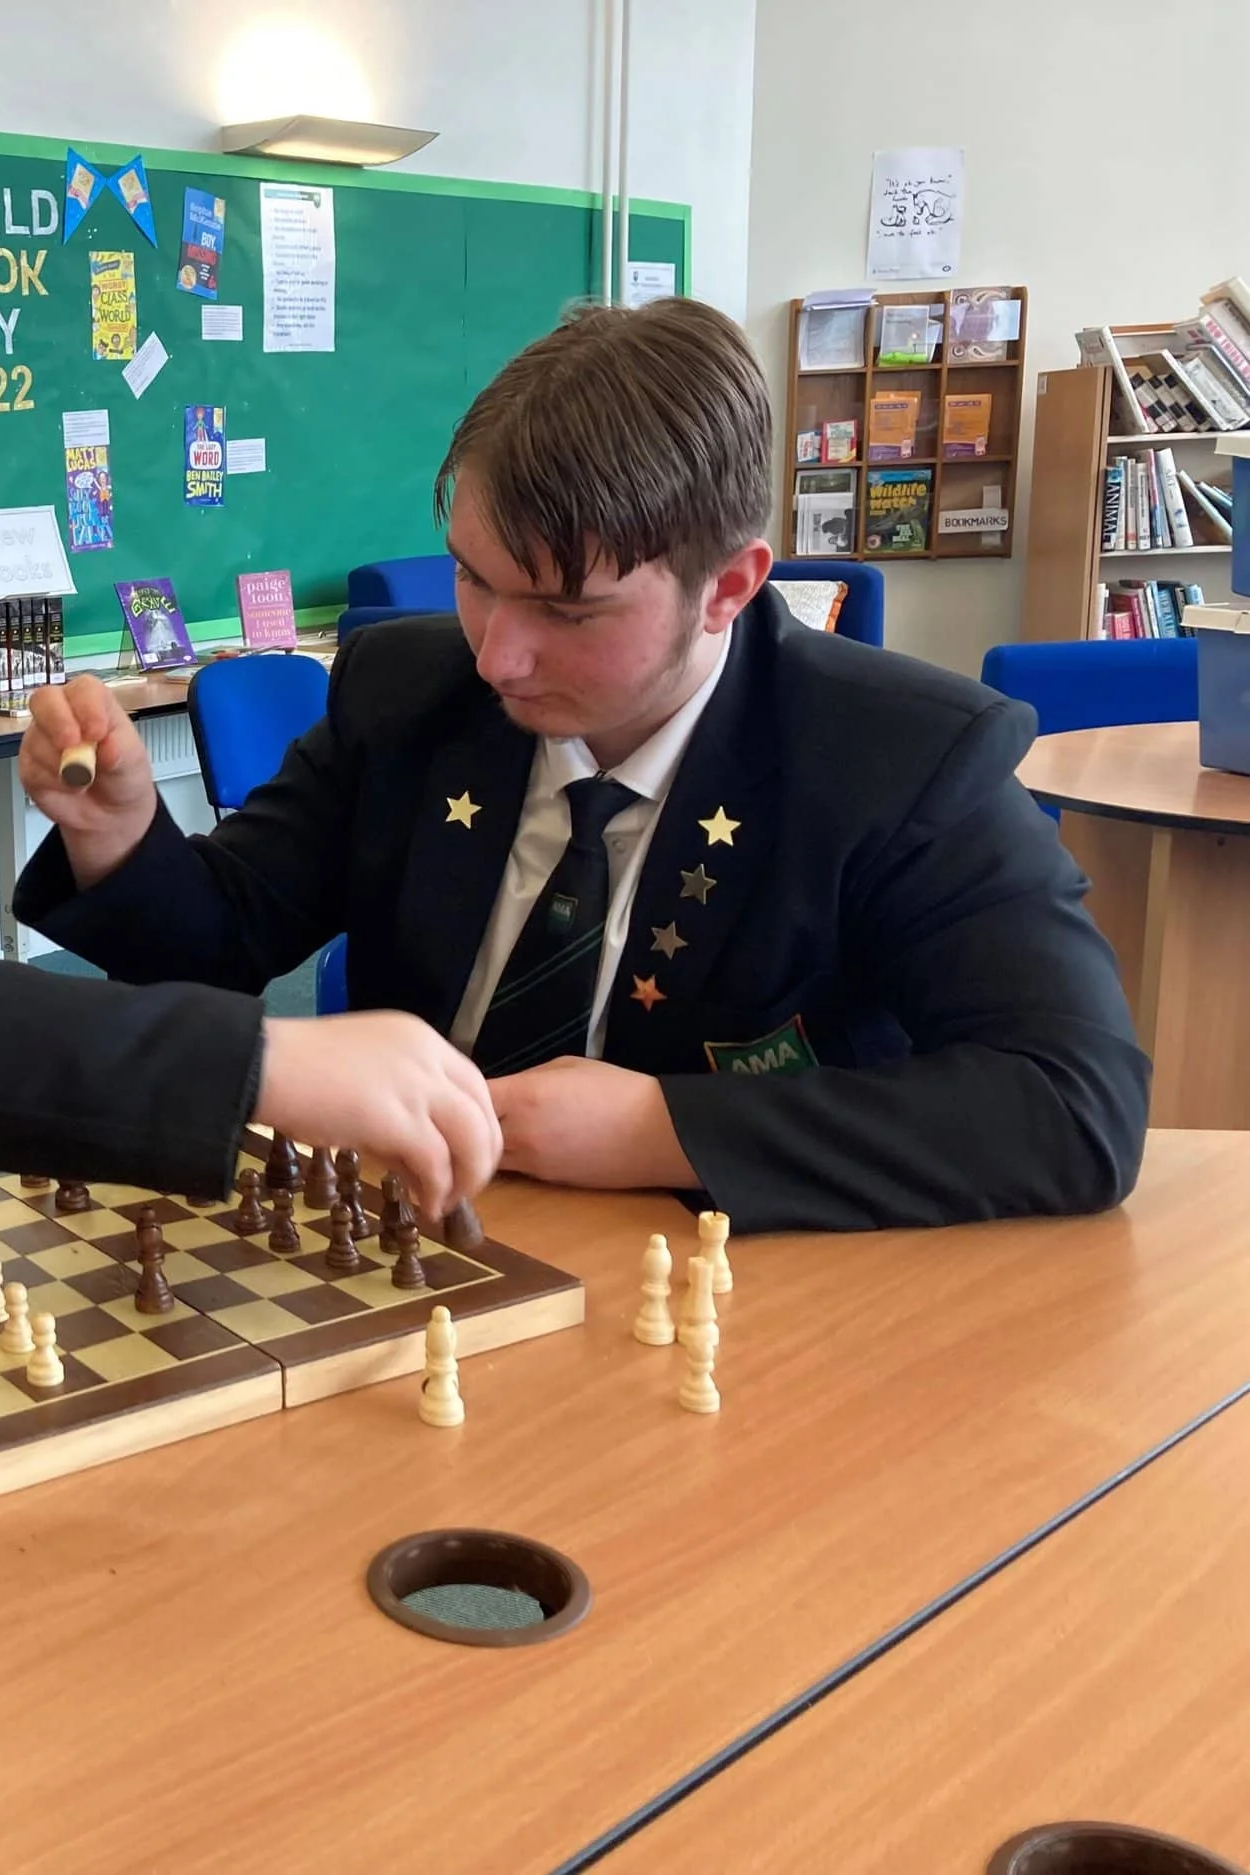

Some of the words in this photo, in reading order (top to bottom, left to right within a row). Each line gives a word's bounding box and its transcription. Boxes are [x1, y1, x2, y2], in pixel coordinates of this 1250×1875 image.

[100, 290, 128, 305] CLASS
[99, 308, 131, 323] WORLD
[66, 446, 95, 460] MATT
[194, 451, 219, 466] WORD
[67, 458, 97, 471] LUCAS
[186, 470, 200, 481] BEN
[186, 481, 222, 498] SMITH
[1100, 483, 1122, 540] ANIMAL
[945, 515, 1007, 529] BOOKMARKS
[246, 578, 286, 595] paige
[732, 1041, 799, 1075] AMA
